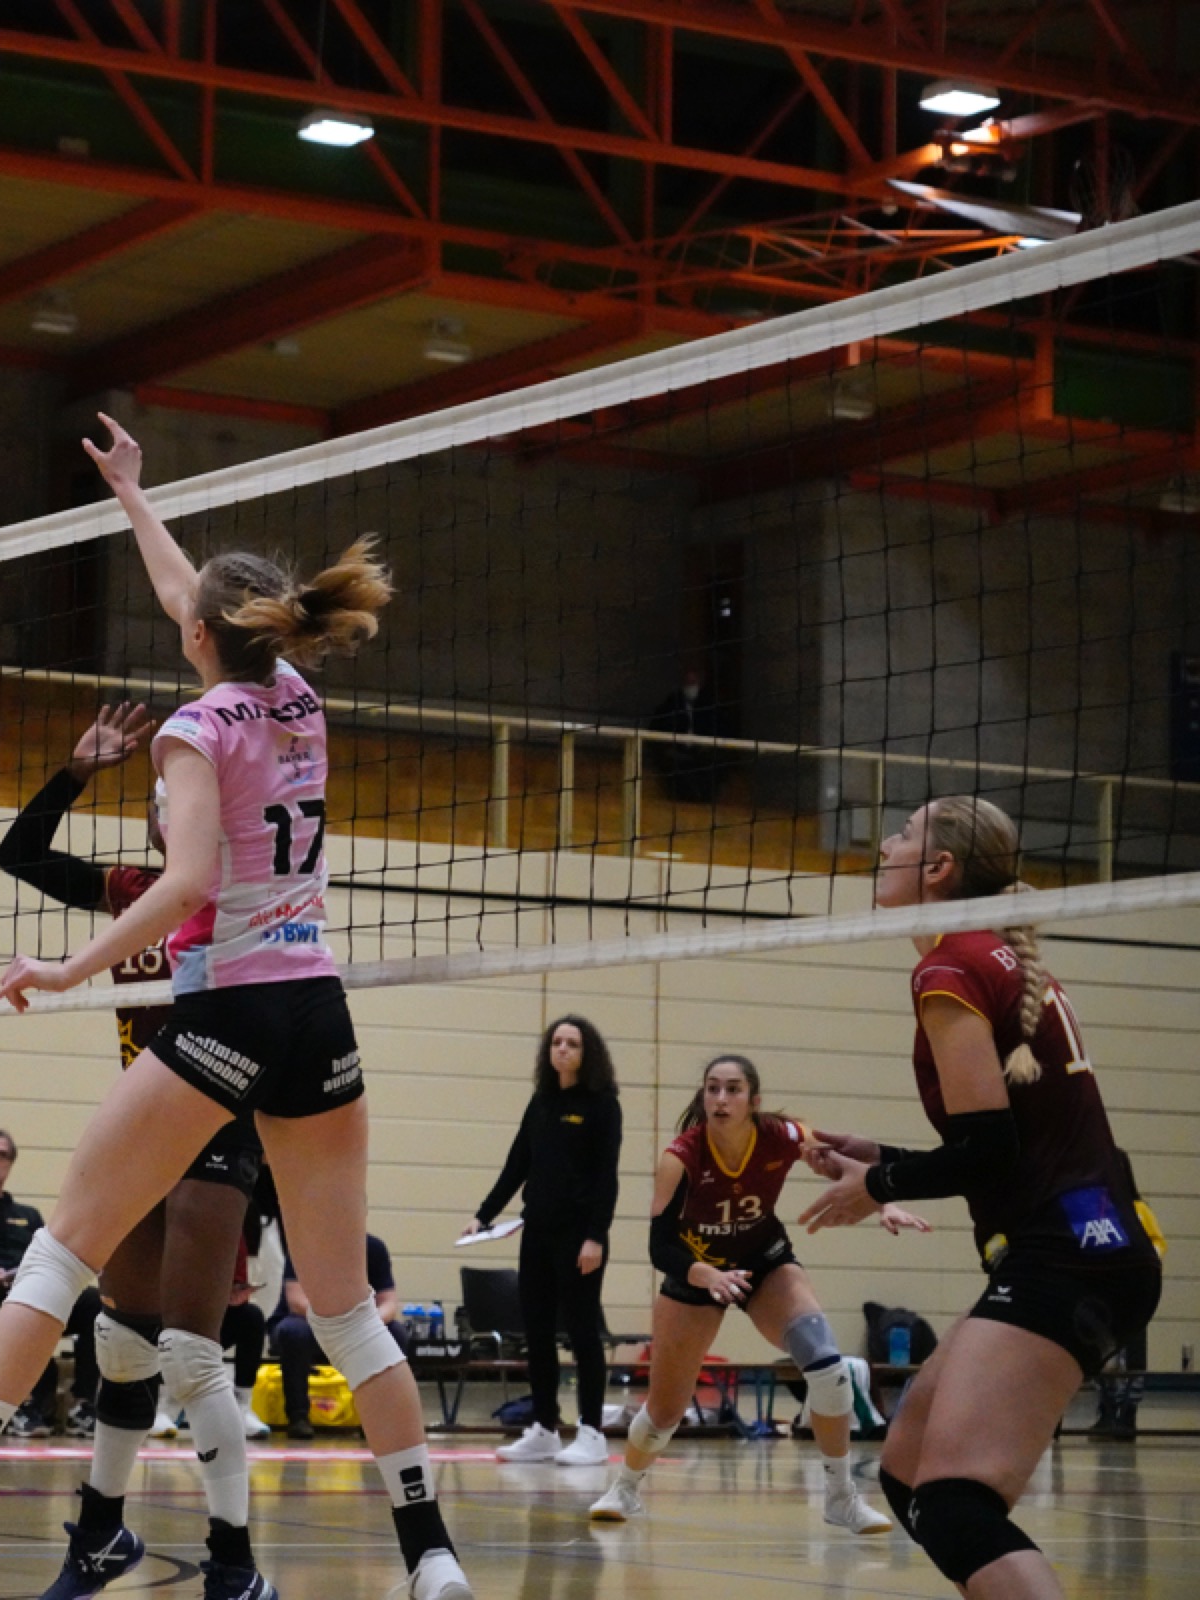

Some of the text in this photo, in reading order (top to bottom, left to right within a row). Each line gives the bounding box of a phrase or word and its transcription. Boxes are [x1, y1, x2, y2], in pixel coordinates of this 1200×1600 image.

[263, 800, 325, 875] 17
[715, 1195, 763, 1223] 13
[1079, 1217, 1123, 1249] AXA
